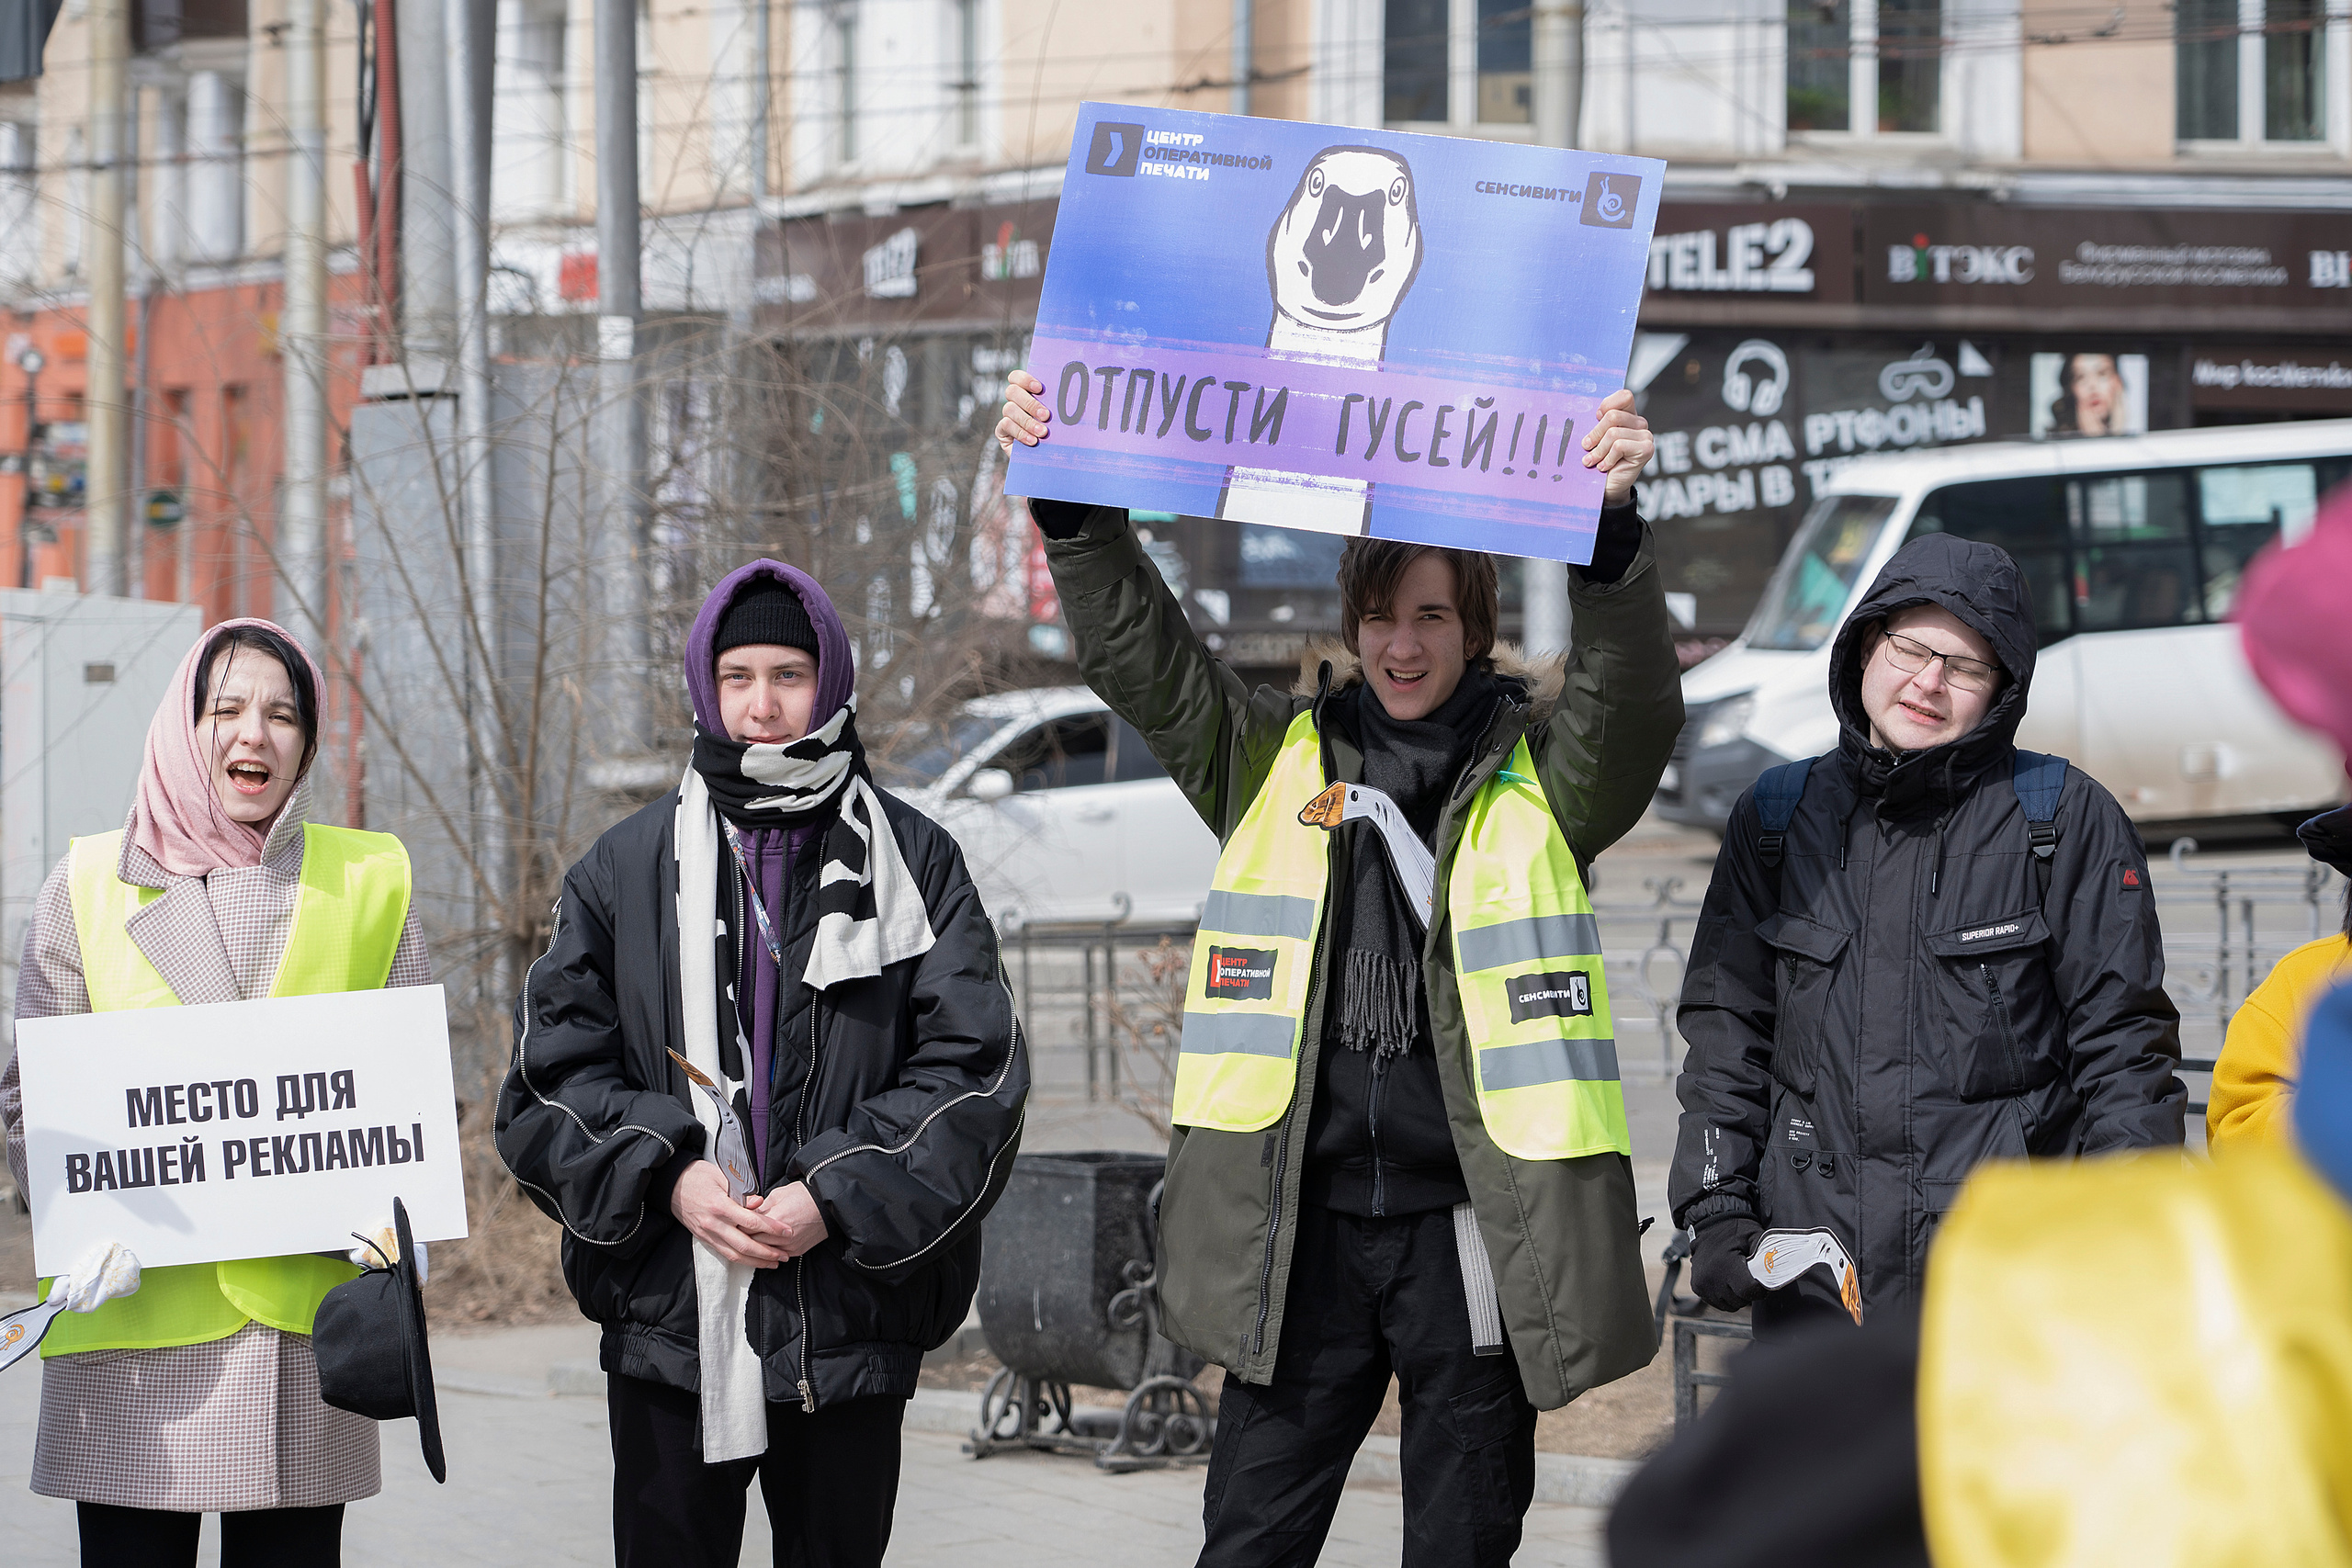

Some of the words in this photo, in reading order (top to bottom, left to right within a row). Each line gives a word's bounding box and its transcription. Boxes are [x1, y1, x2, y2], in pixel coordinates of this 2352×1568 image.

[1147, 130, 1204, 146] ЦЕНТР
[1144, 146, 1272, 170] ОПЕРАТИВНОЙ
[1140, 162, 1210, 181] ПЕЧАТИ
[1476, 181, 1582, 203] СЕНСИВИТИ
[1648, 217, 1815, 292] TELE2
[1057, 360, 1289, 446] ОТПУСТИ
[1335, 393, 1575, 482] ГУСЕЙ!!!
[1759, 464, 1796, 510] В
[1962, 928, 1994, 942] SUPERIOR
[1995, 924, 2019, 936] RAPID+
[1221, 957, 1248, 967] ЦЕНТР
[1219, 977, 1250, 987] ПЕЧАТИ
[1220, 967, 1272, 978] ОПЕРАТИВНОЙ
[1519, 989, 1571, 1003] СЕНСИВИТИ
[125, 1077, 259, 1128] МЕСТО
[276, 1069, 356, 1122] ДЛЯ
[65, 1135, 207, 1194] ВАШЕЙ
[222, 1122, 424, 1180] РЕКЛАМЫ
